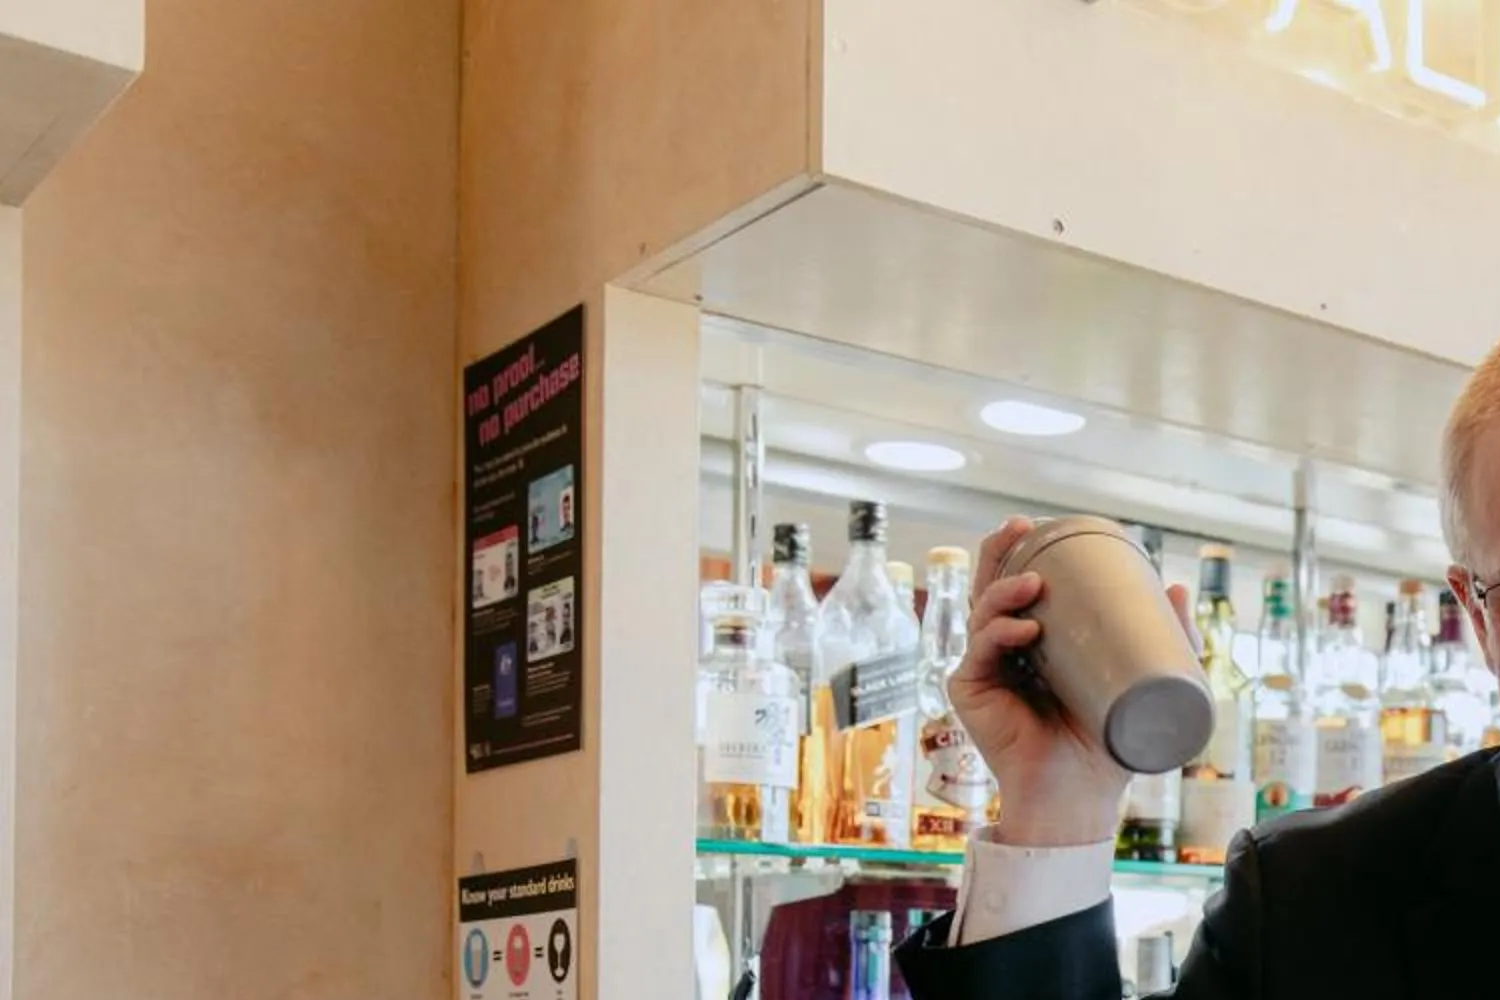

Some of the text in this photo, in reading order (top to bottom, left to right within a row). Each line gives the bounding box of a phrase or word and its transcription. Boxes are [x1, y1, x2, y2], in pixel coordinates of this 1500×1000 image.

[468, 383, 489, 416] no
[479, 351, 579, 447] no purchase
[487, 887, 507, 907] your
[509, 878, 547, 899] standard
[547, 872, 575, 893] drinks
